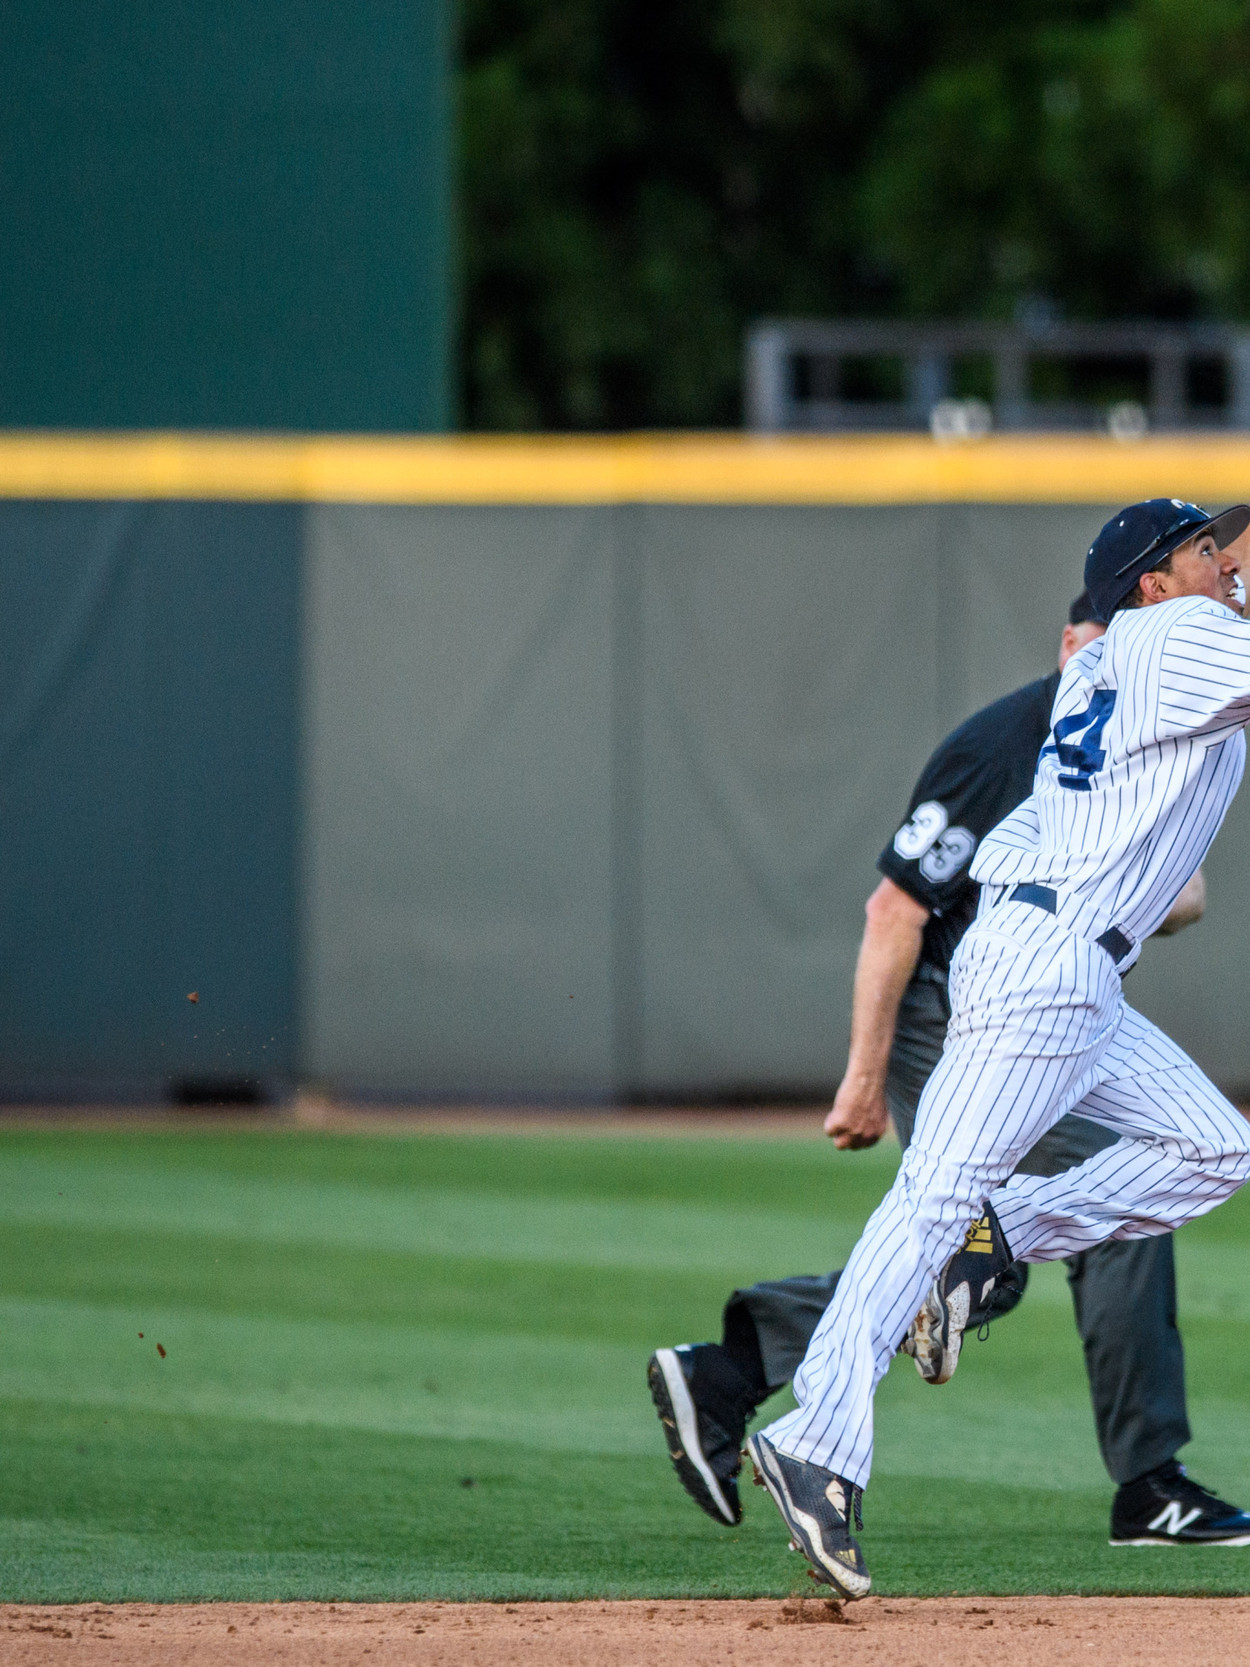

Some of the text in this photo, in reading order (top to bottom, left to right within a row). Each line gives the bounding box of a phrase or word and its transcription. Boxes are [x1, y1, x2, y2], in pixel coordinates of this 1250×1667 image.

[1035, 689, 1117, 792] 4
[894, 800, 977, 883] 33
[1147, 1501, 1202, 1535] N
